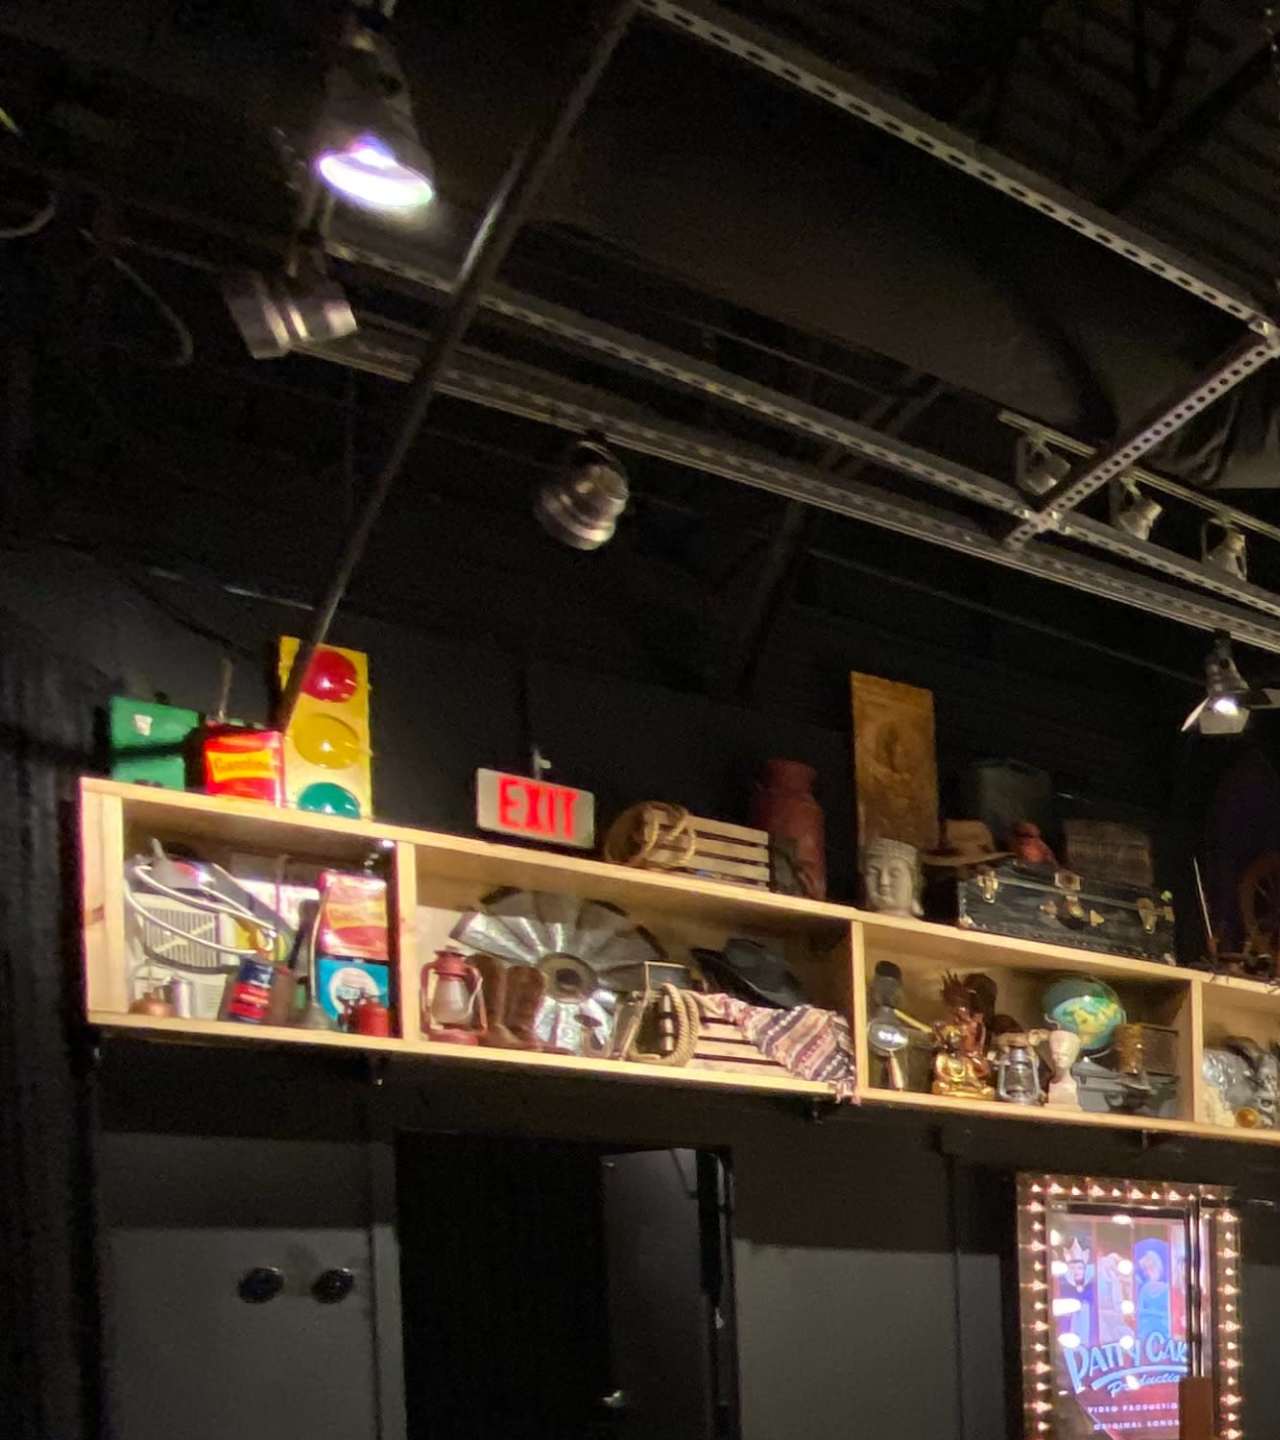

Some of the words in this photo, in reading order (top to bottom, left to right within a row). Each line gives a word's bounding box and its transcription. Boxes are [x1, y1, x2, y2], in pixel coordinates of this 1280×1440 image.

[499, 776, 579, 840] EXIT
[1146, 1331, 1188, 1363] CAK
[1123, 1402, 1178, 1411] PRODUCTIO
